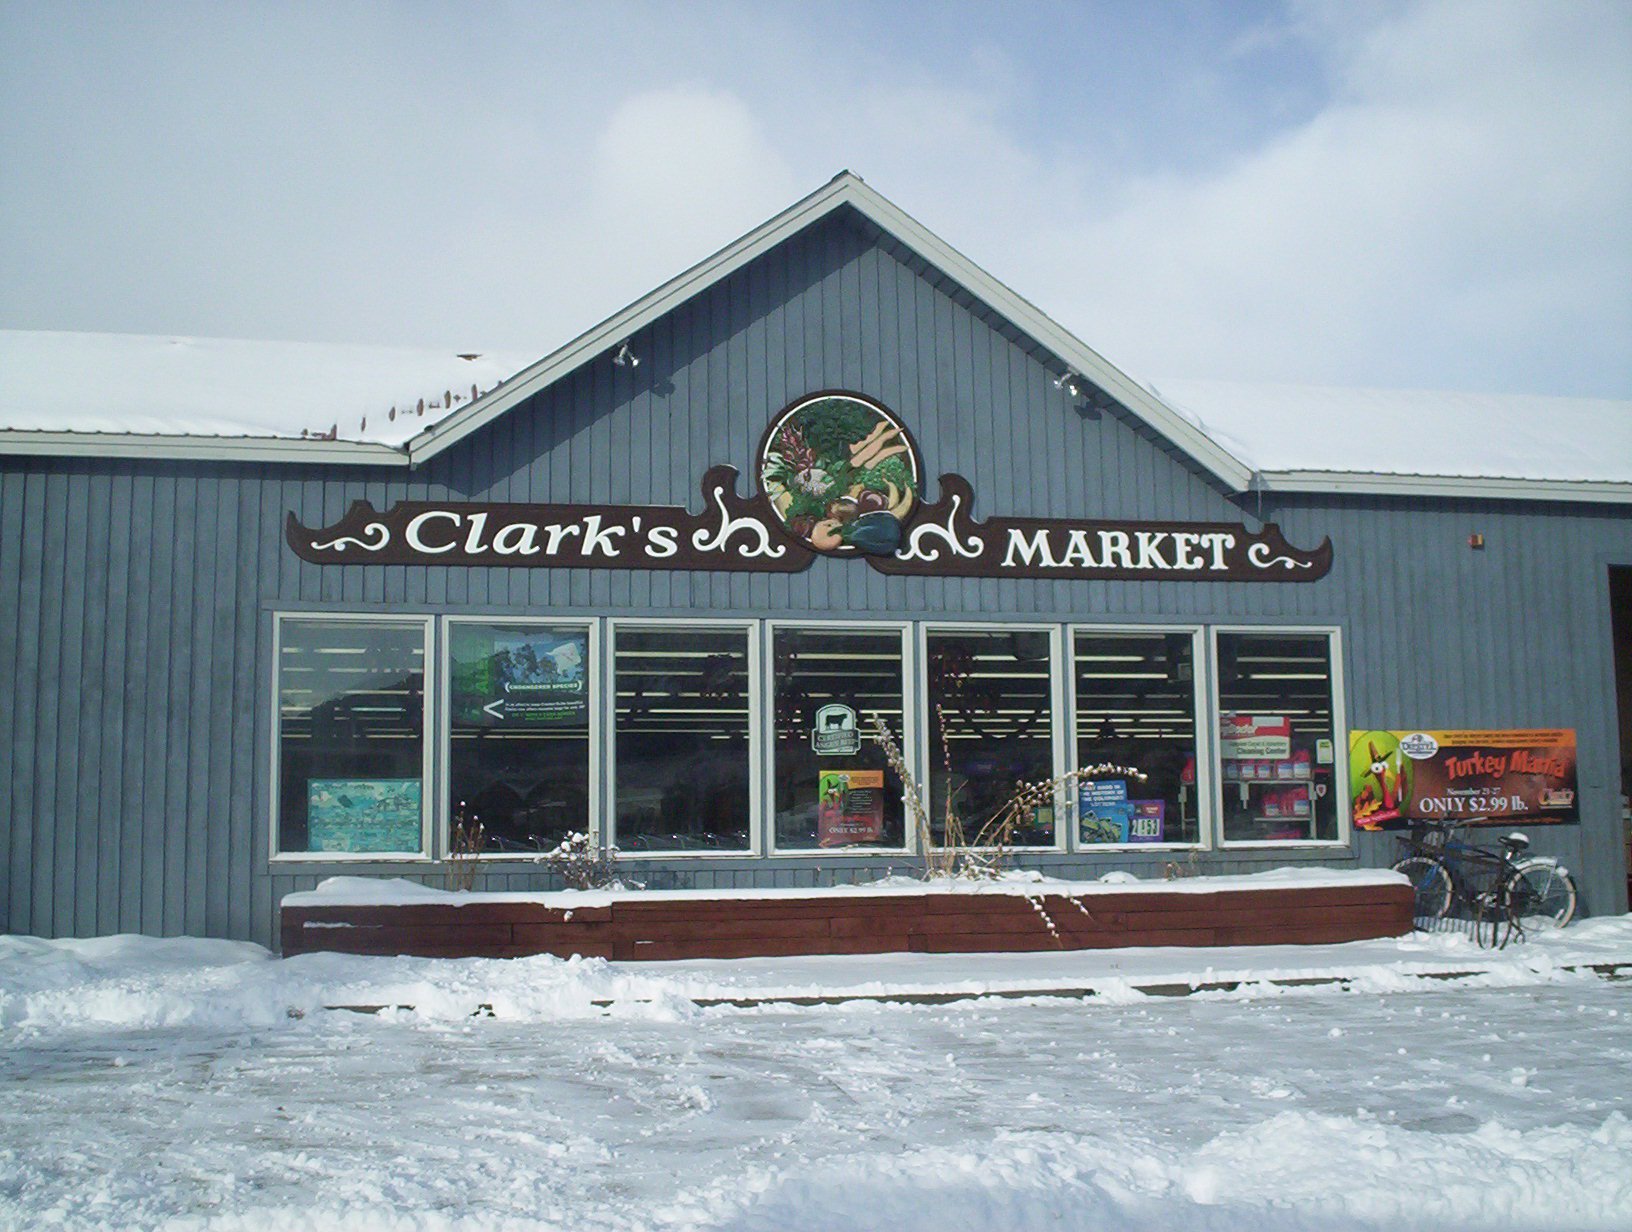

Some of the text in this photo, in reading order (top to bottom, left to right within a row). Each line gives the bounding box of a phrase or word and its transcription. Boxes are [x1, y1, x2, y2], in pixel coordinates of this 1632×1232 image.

[404, 510, 679, 559] Clark's
[1000, 528, 1236, 571] MARKET
[1445, 751, 1506, 780] Turkey
[1468, 795, 1508, 813] $2.99
[1511, 795, 1529, 811] lb.
